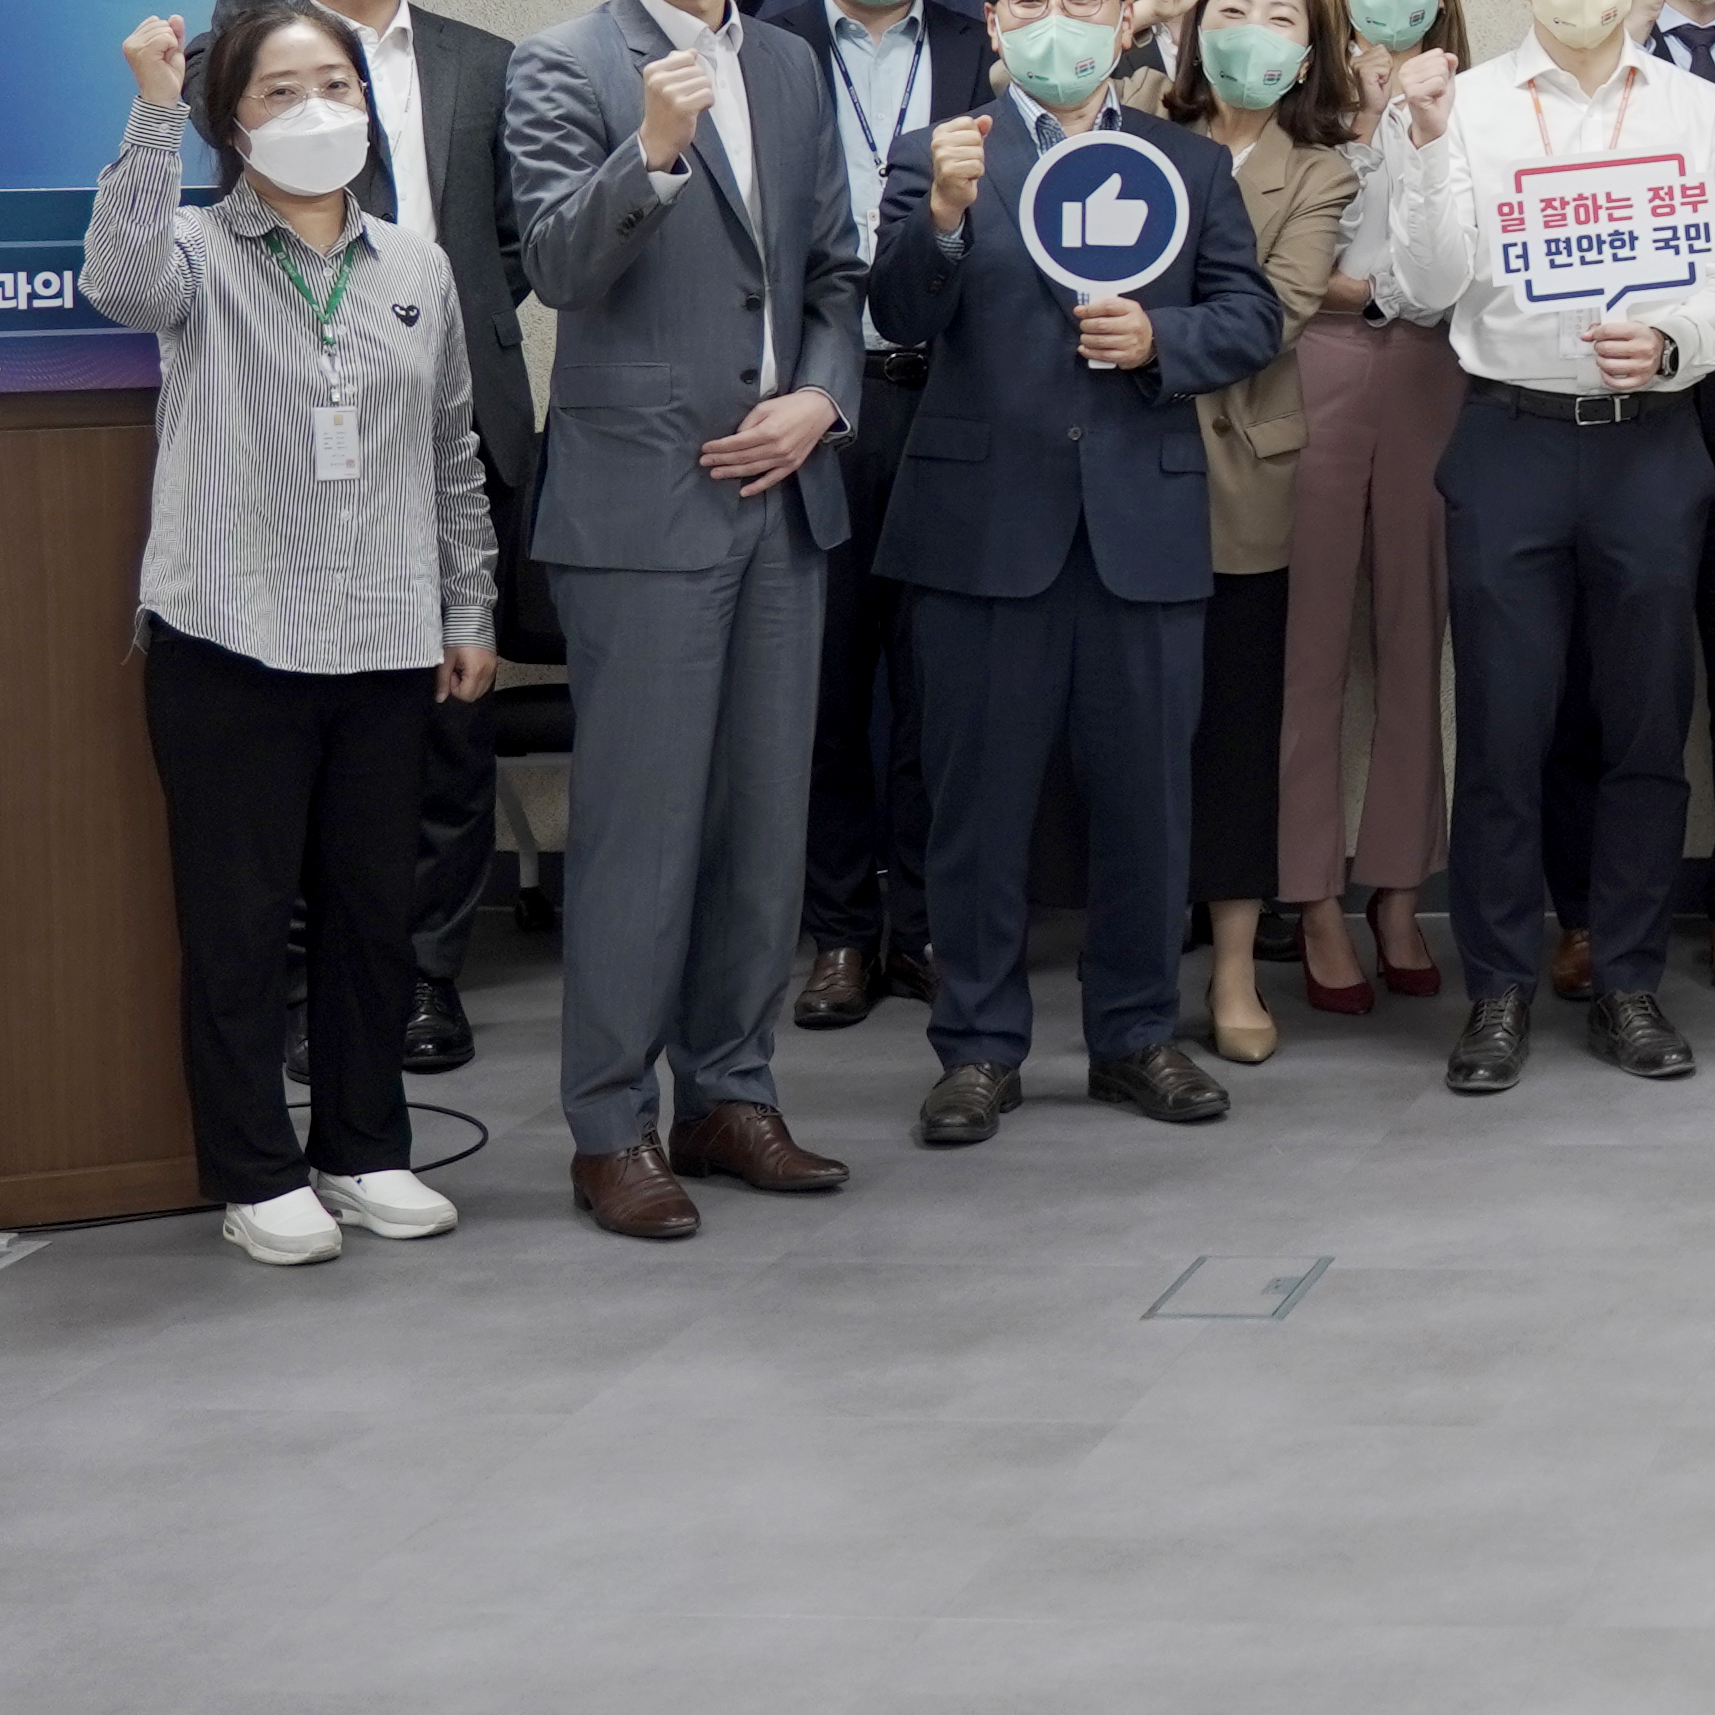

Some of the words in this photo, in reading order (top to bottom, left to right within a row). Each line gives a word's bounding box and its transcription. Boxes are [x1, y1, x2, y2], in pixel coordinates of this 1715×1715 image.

[1497, 200, 1528, 234] 일
[1539, 191, 1634, 230] 잘하는
[1647, 182, 1710, 219] 정부
[1502, 240, 1531, 274] 더
[1544, 230, 1639, 270] 편안한
[1652, 222, 1713, 258] 국민
